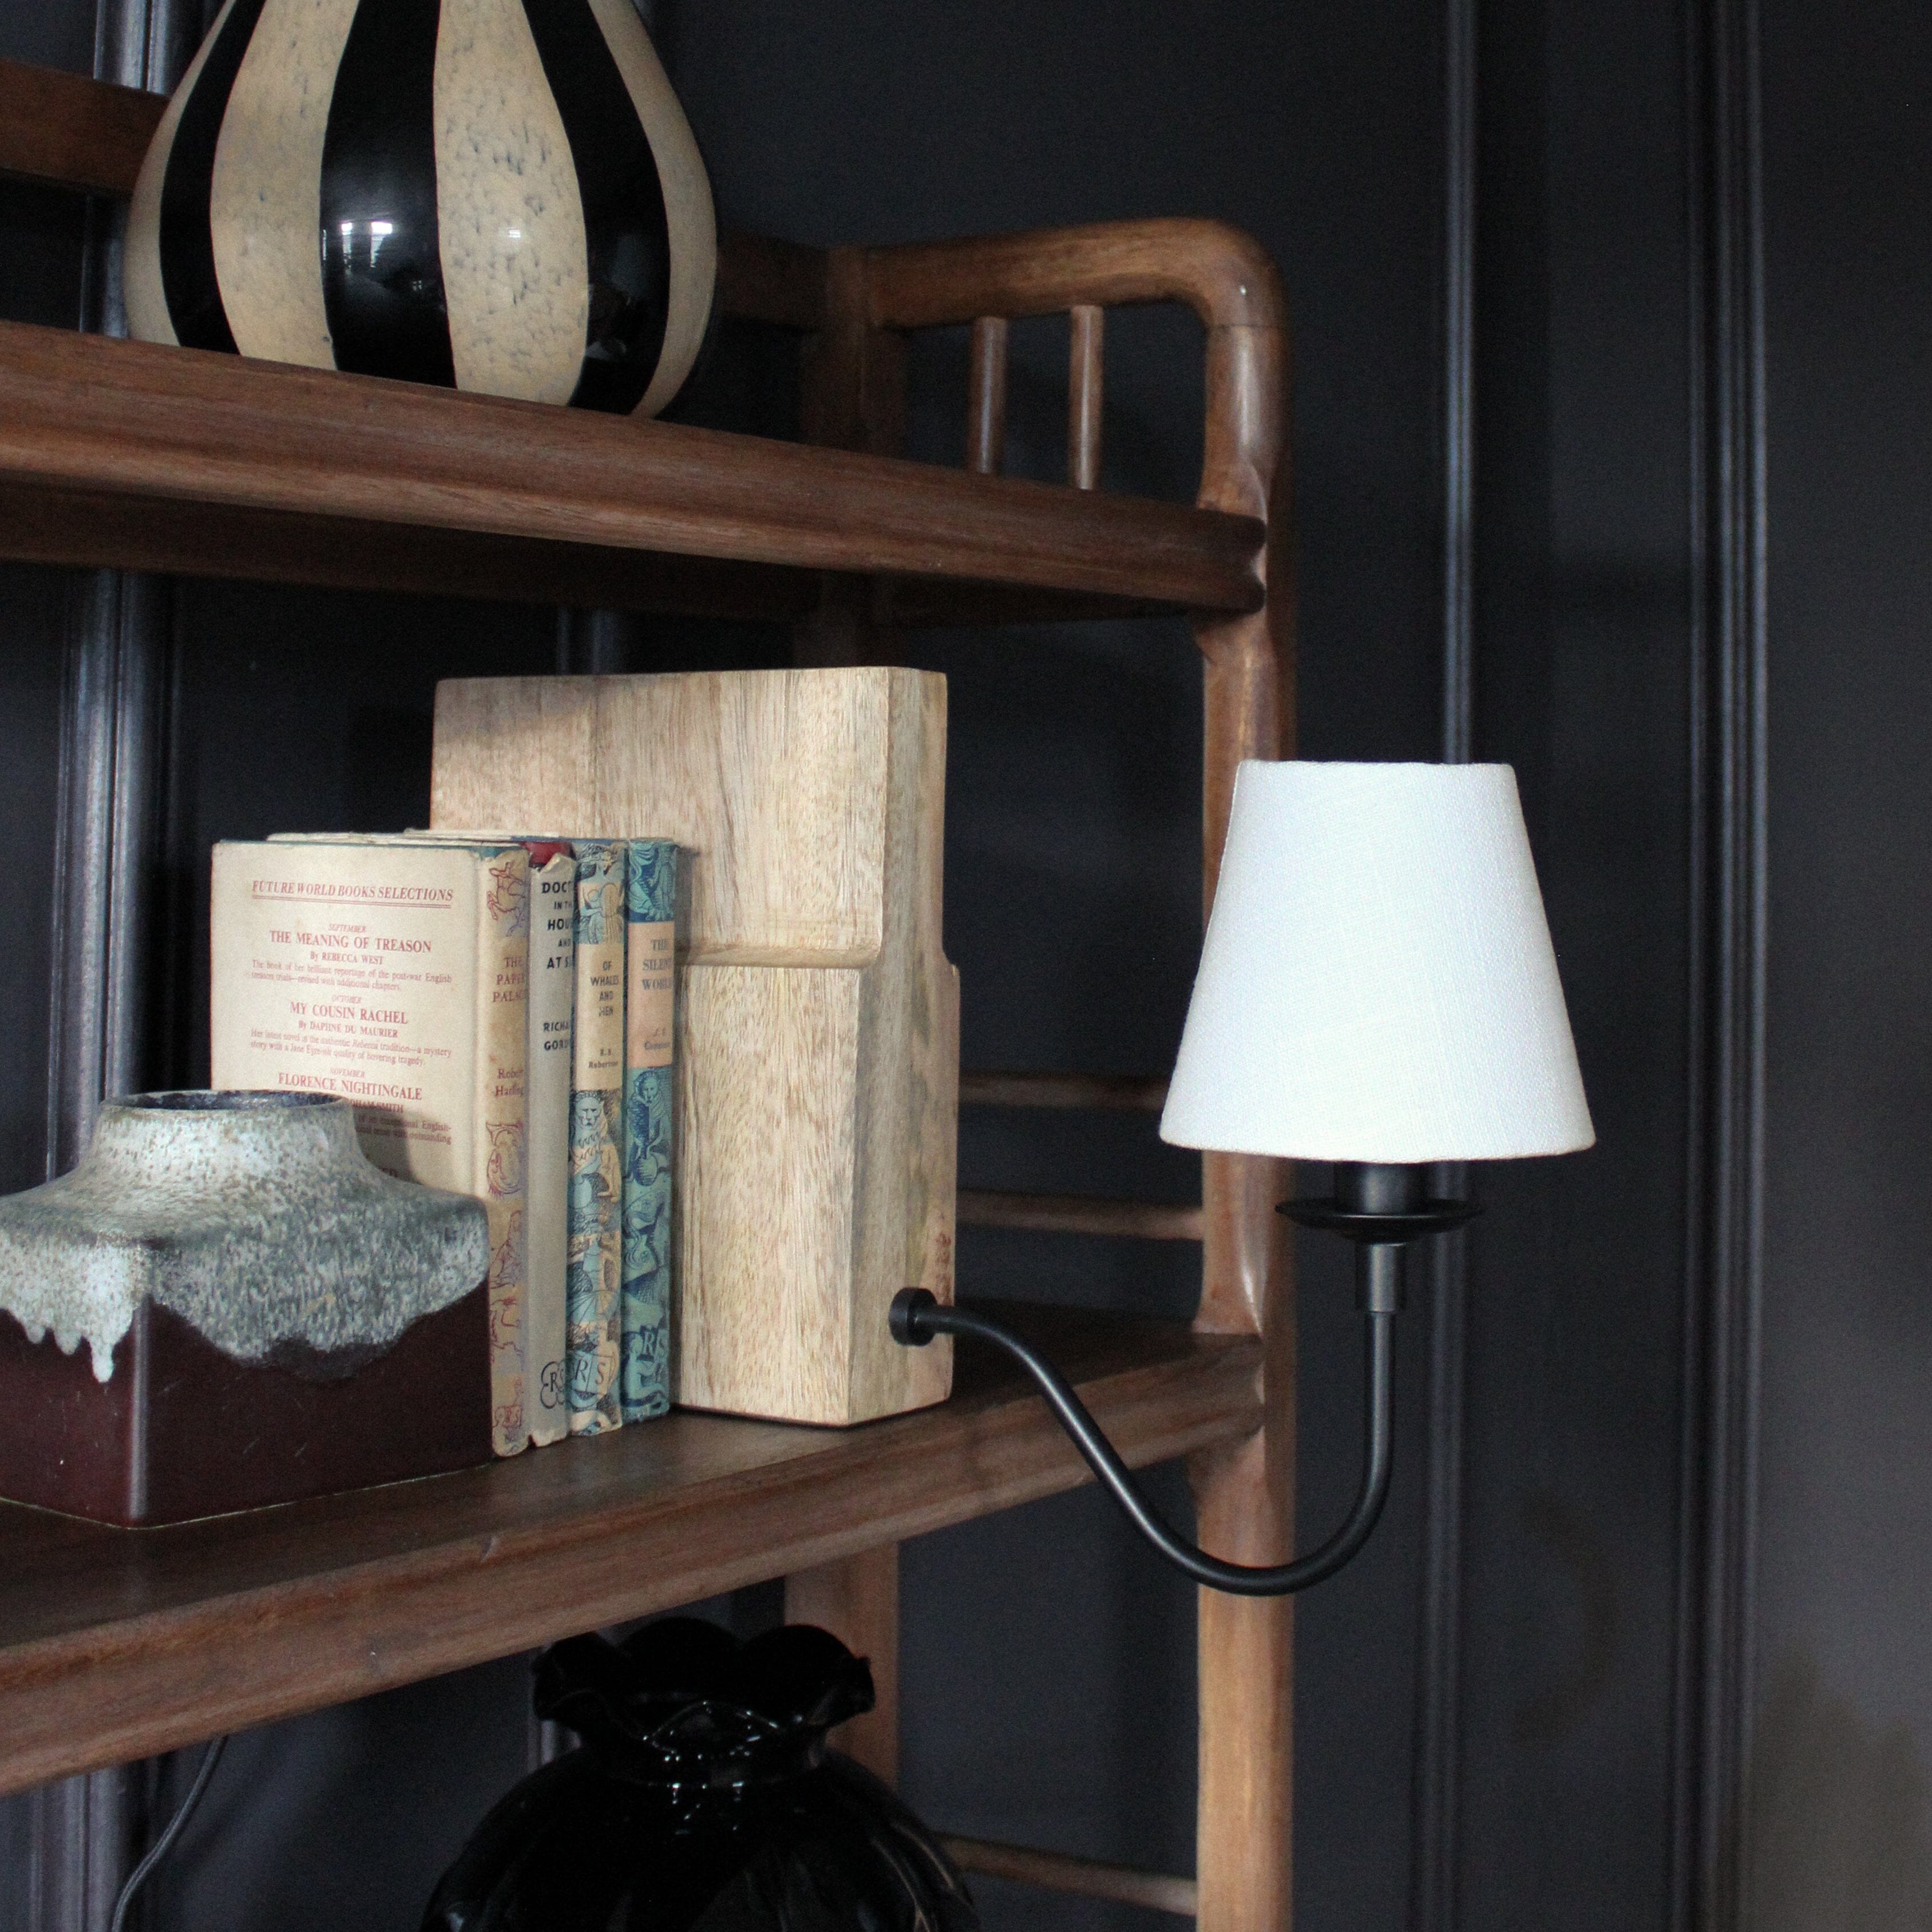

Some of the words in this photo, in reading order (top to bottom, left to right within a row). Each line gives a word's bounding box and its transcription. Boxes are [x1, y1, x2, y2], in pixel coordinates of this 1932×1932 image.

[252, 880, 295, 893] FUTURE
[297, 882, 335, 896] WORLD
[338, 885, 375, 898] BOOKS
[377, 886, 453, 901] SELECTIONS
[553, 901, 563, 910] IN
[329, 923, 366, 933] SEPTEMBER
[270, 930, 291, 943] THE
[296, 932, 349, 948] MEANING
[354, 936, 369, 949] OF
[375, 937, 431, 953] TREASON
[310, 951, 318, 961] By
[322, 952, 358, 964] REBECCA
[361, 954, 384, 965] WEST
[547, 956, 562, 969] AT
[602, 961, 612, 971] OF
[368, 969, 376, 978] of
[378, 969, 389, 979] the
[392, 972, 422, 982] post-war
[425, 972, 453, 985] English
[290, 1001, 307, 1015] MY
[312, 1004, 355, 1020] COUSIN
[360, 1008, 408, 1024] RACHEL
[298, 1020, 307, 1030] By
[310, 1021, 342, 1034] DAPHNE
[345, 1025, 357, 1035] DU
[360, 1026, 398, 1038] MAURIER
[423, 1047, 453, 1059] mystery
[278, 1072, 336, 1091] FLORENCE
[341, 1079, 422, 1100] NIGHTINGALE
